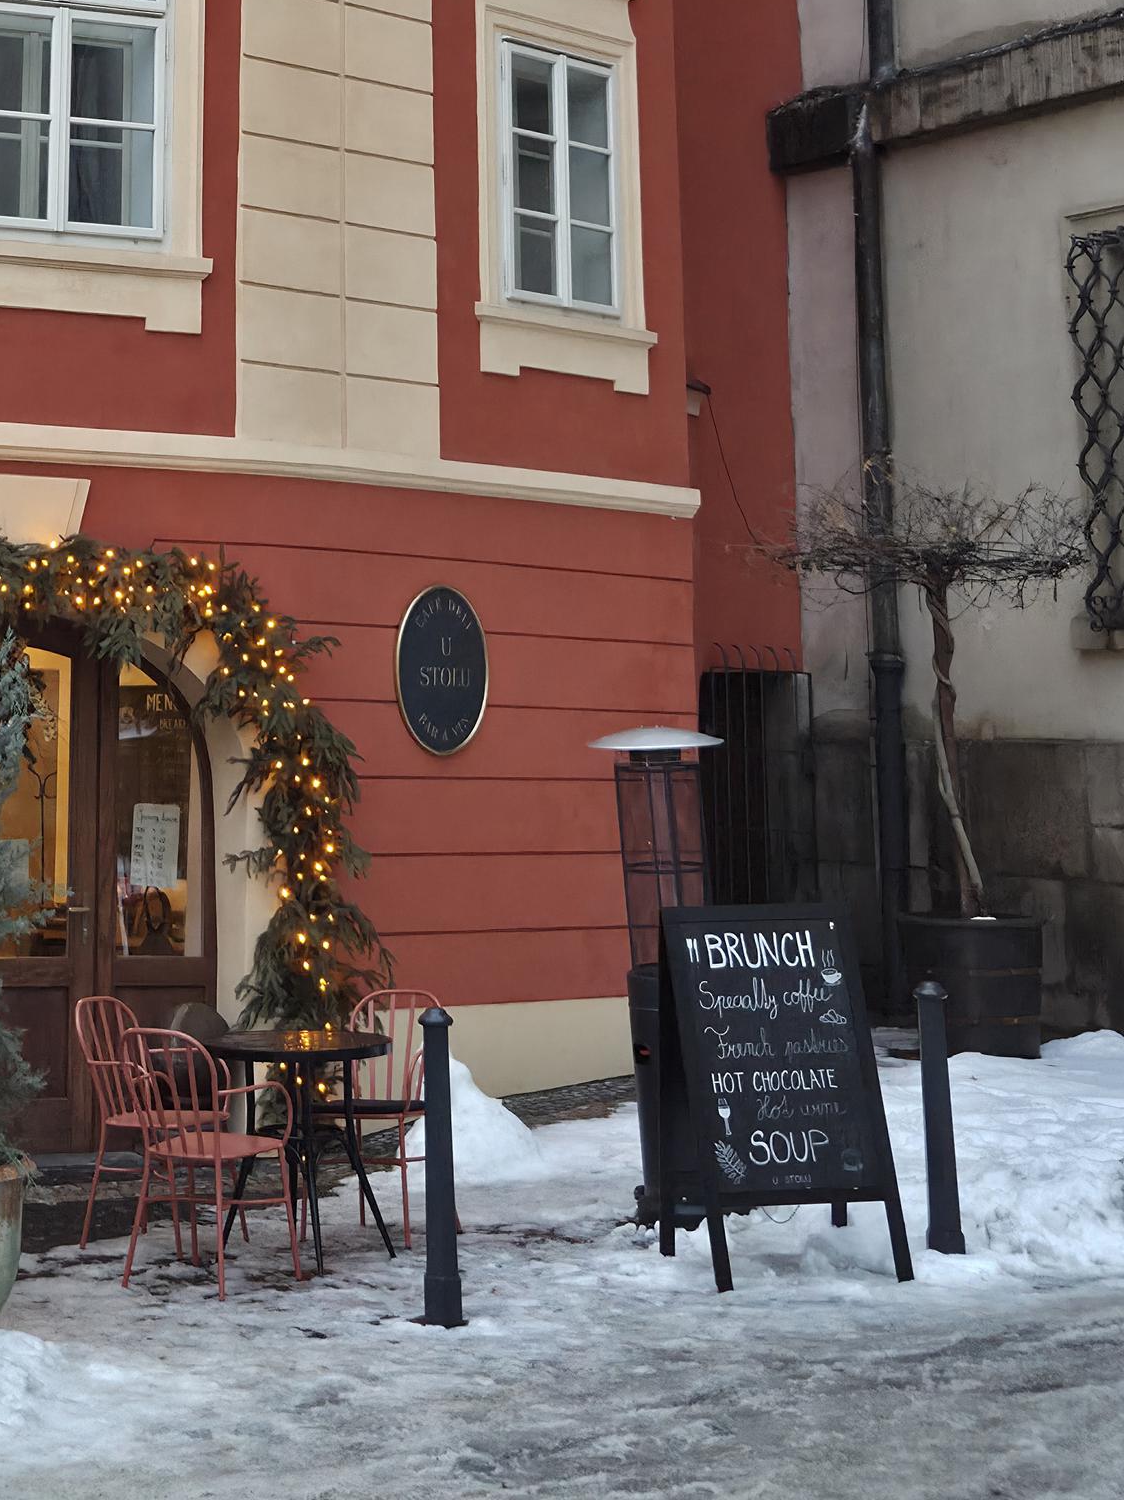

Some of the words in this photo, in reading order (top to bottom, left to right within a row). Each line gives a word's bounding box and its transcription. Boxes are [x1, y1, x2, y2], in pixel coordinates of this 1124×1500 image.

[441, 637, 452, 656] U
[420, 666, 470, 688] STOLU
[146, 693, 174, 712] MEN
[704, 930, 816, 969] BRUNCH
[783, 978, 833, 1013] coffee
[704, 1025, 775, 1060] French
[784, 1027, 850, 1064] pastries
[711, 1071, 744, 1094] HOT
[752, 1068, 838, 1093] CHOCOLATE
[749, 1128, 829, 1166] SOUP
